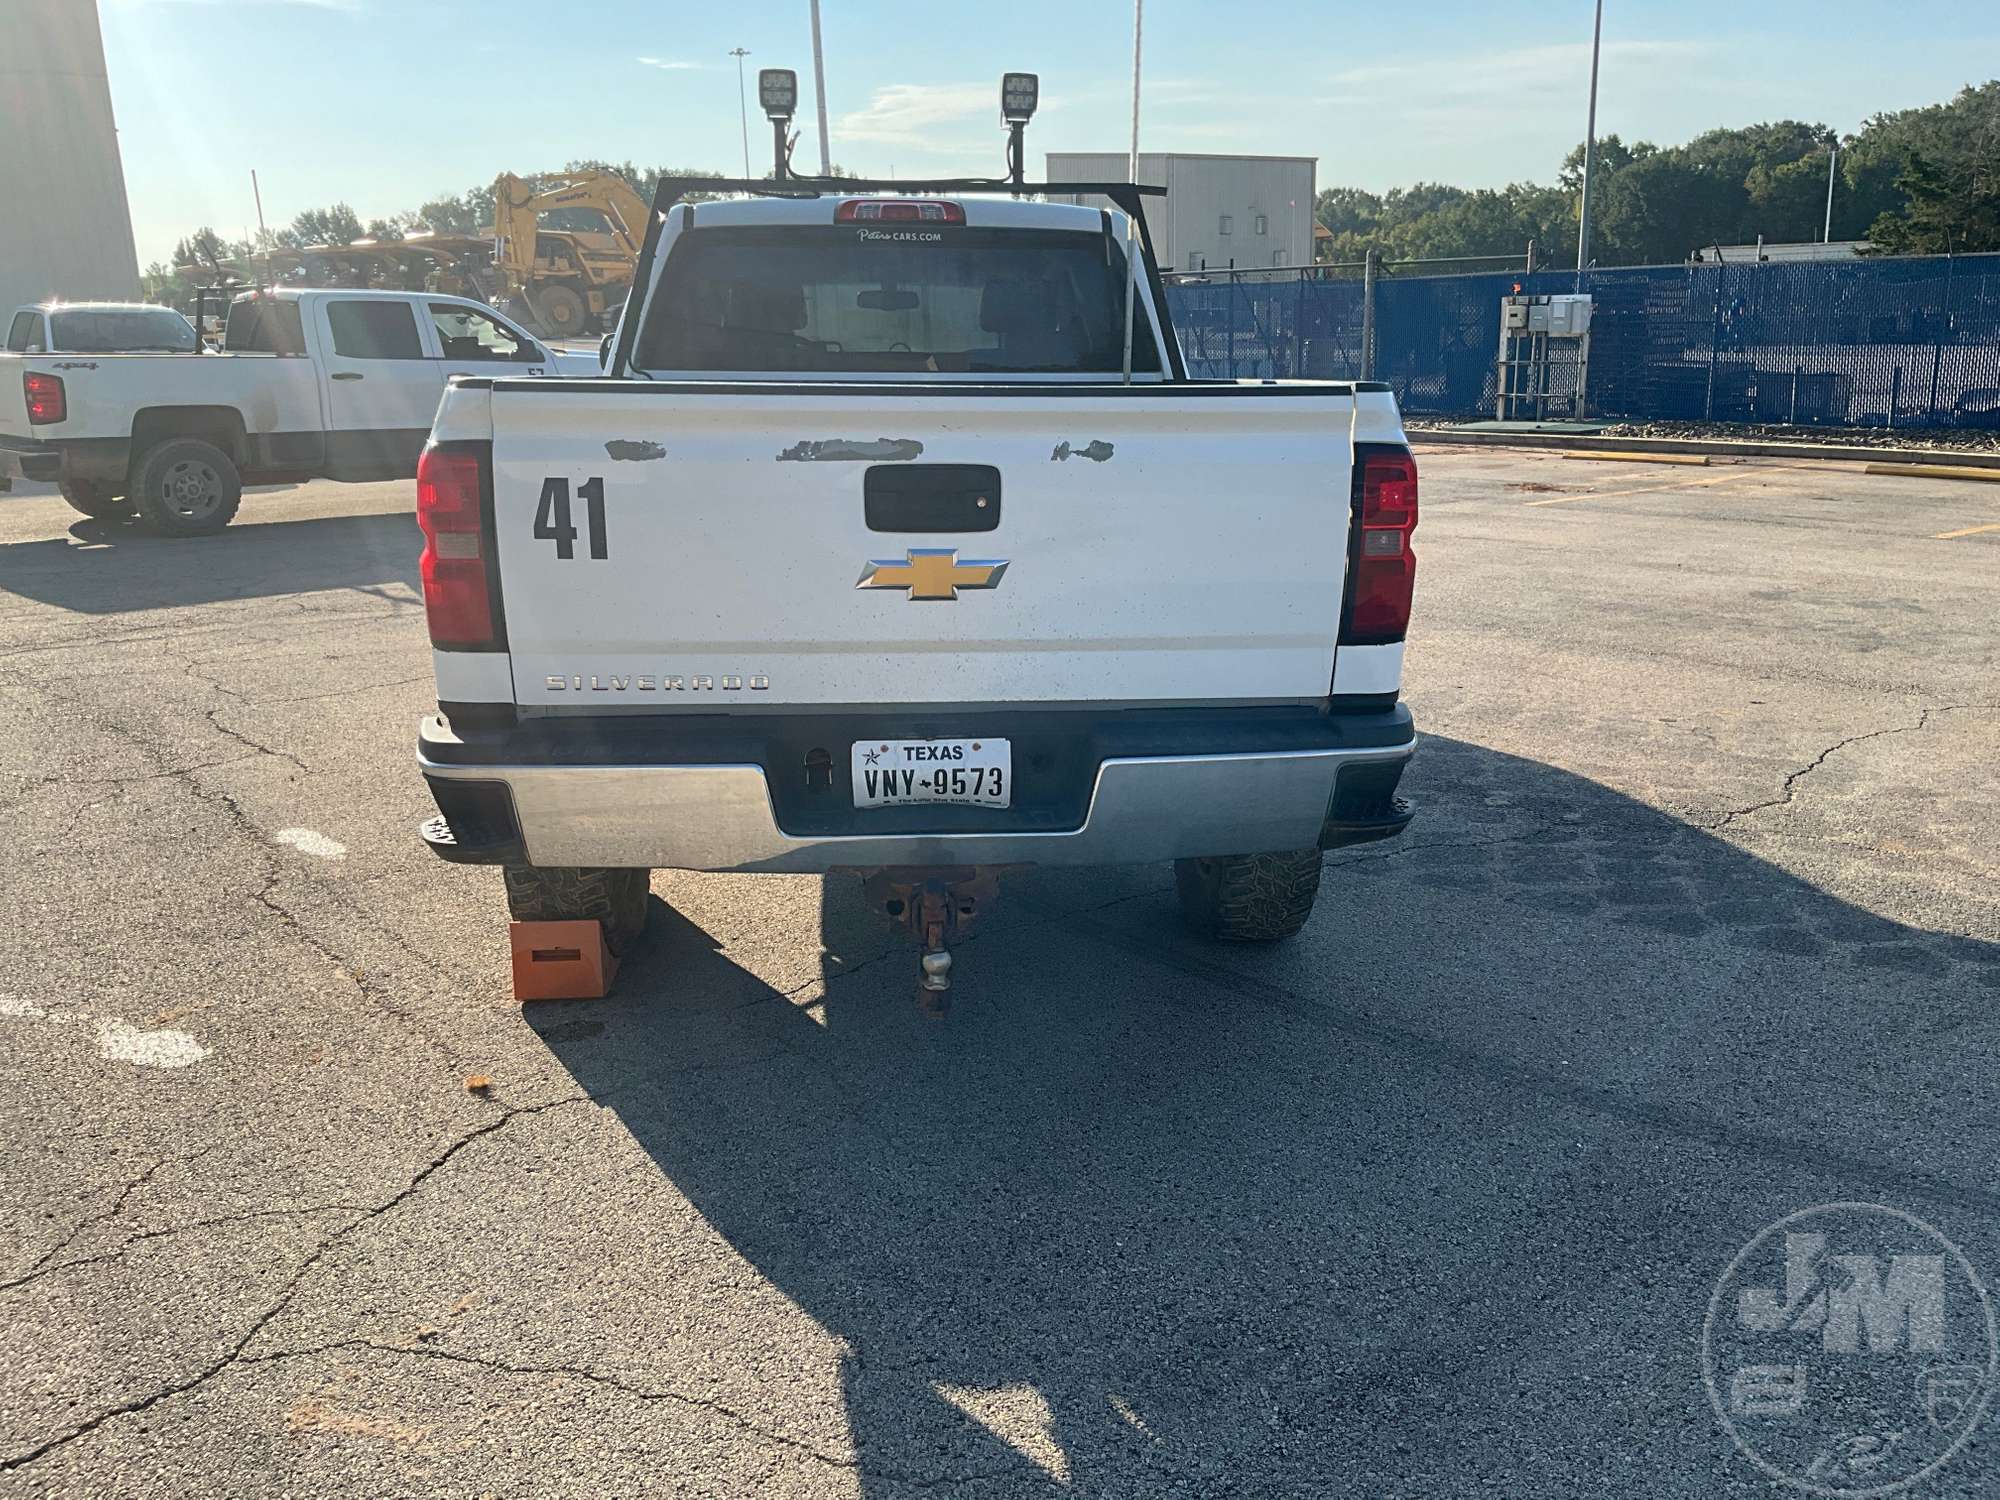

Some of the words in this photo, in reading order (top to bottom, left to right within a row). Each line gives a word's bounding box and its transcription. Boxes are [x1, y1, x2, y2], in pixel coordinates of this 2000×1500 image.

[533, 477, 608, 560] 41
[545, 674, 770, 691] SILVERADO
[903, 744, 964, 762] TEXAS
[933, 767, 1003, 797] 9573
